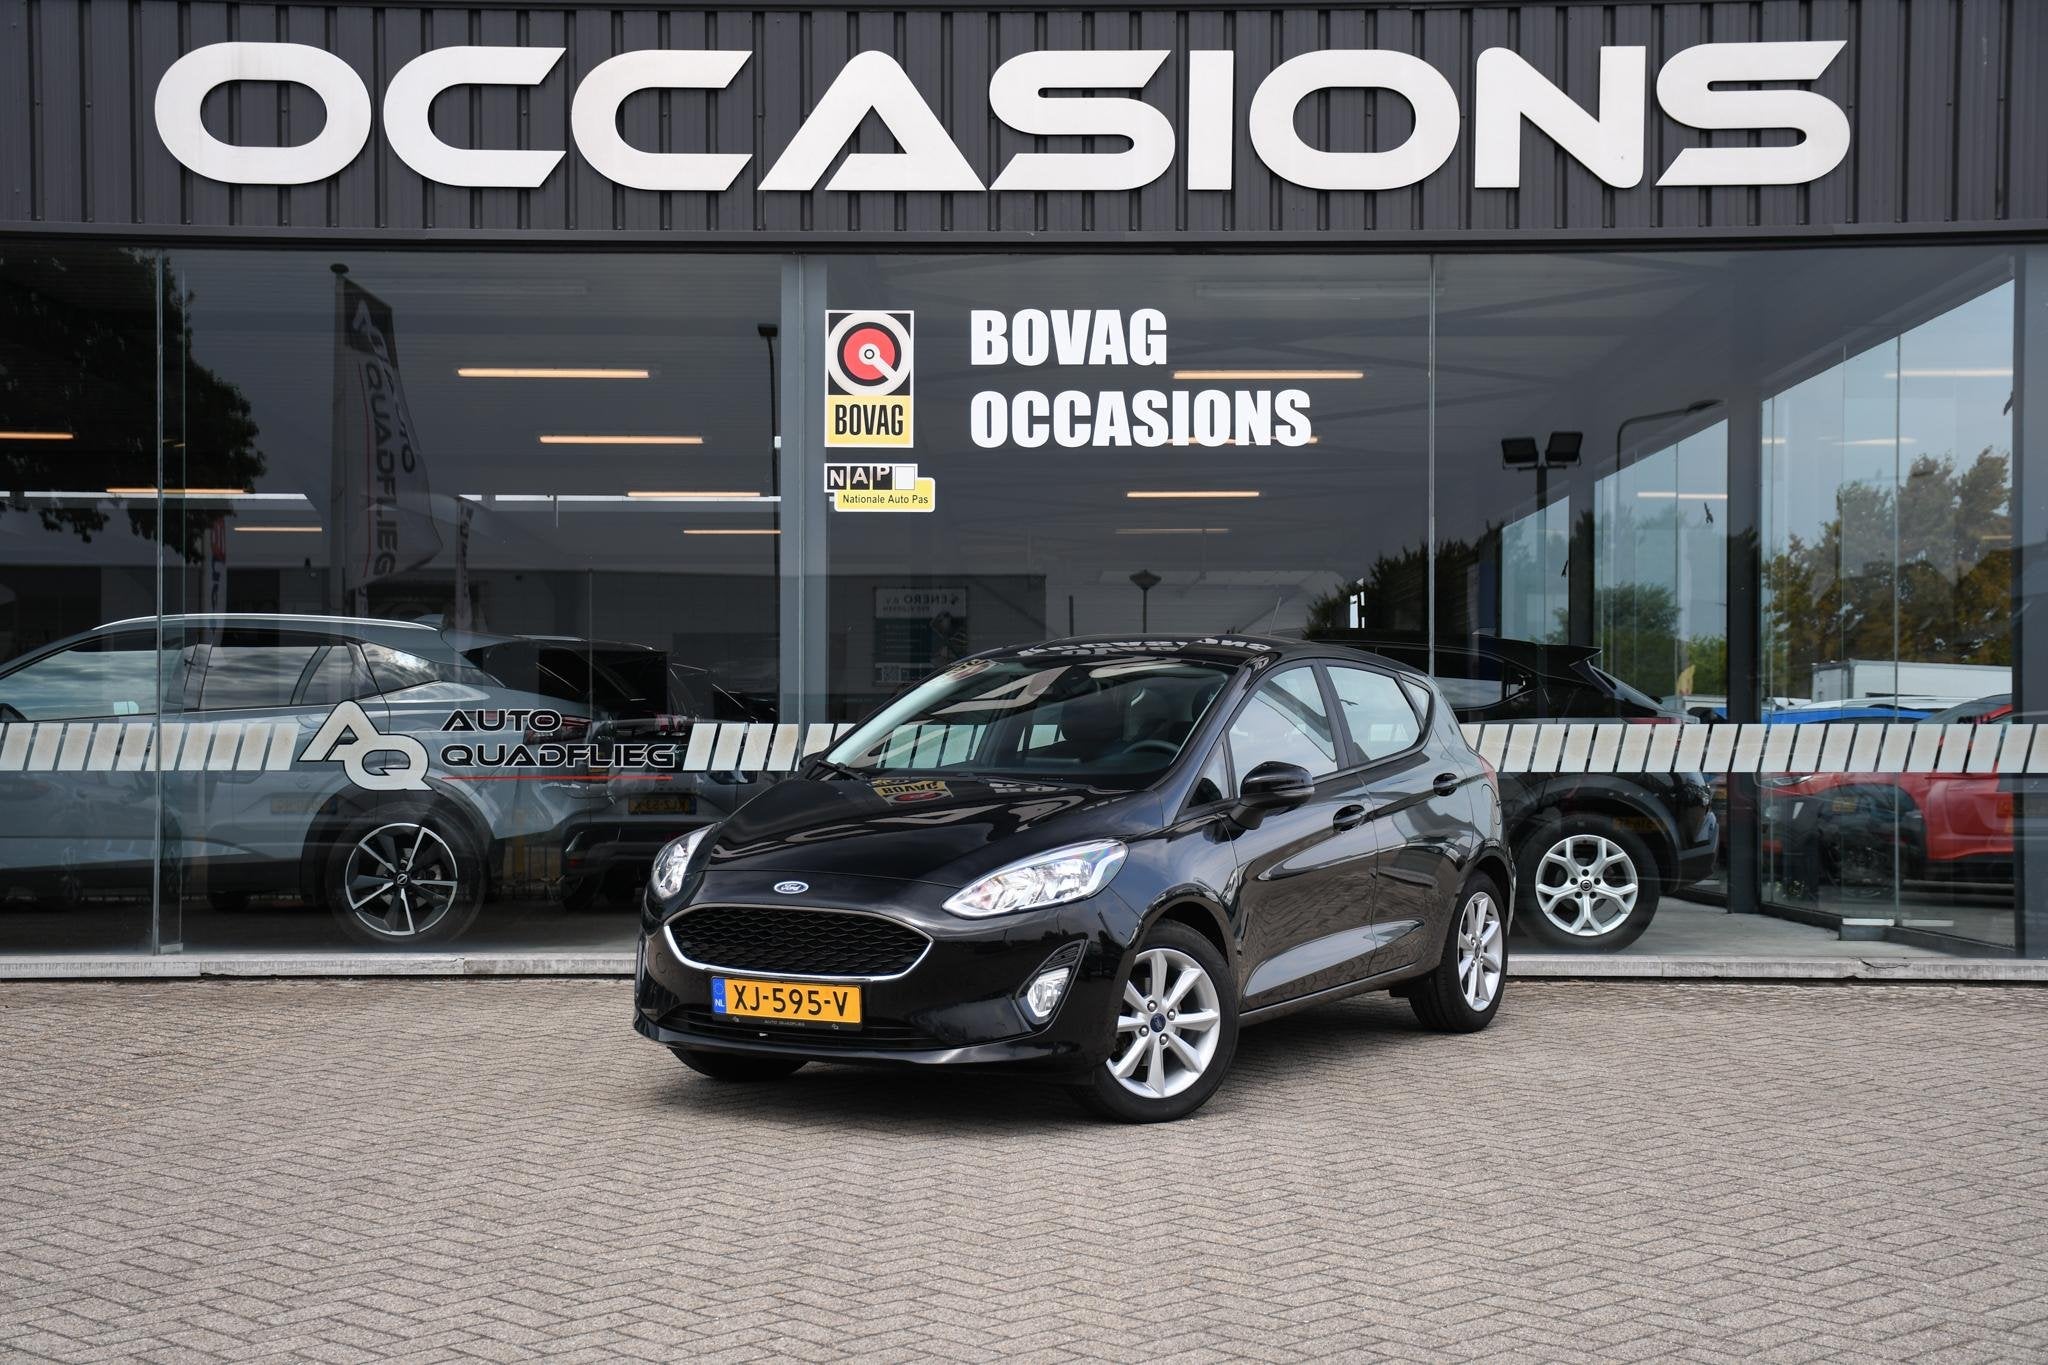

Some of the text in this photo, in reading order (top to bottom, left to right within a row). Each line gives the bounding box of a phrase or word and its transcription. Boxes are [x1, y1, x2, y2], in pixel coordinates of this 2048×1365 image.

[155, 40, 1852, 191] OCCASIONS
[971, 308, 1167, 366] BOVAG
[834, 403, 904, 436] BOVAG
[971, 389, 1312, 448] OCCASIONS
[829, 466, 891, 487] NAP
[842, 494, 929, 504] Nationale Auto Pas
[440, 708, 563, 732] AUTO
[297, 699, 433, 791] AQ
[440, 743, 677, 769] QUADFLIEG
[714, 984, 848, 1017] NL XJ-595-V
